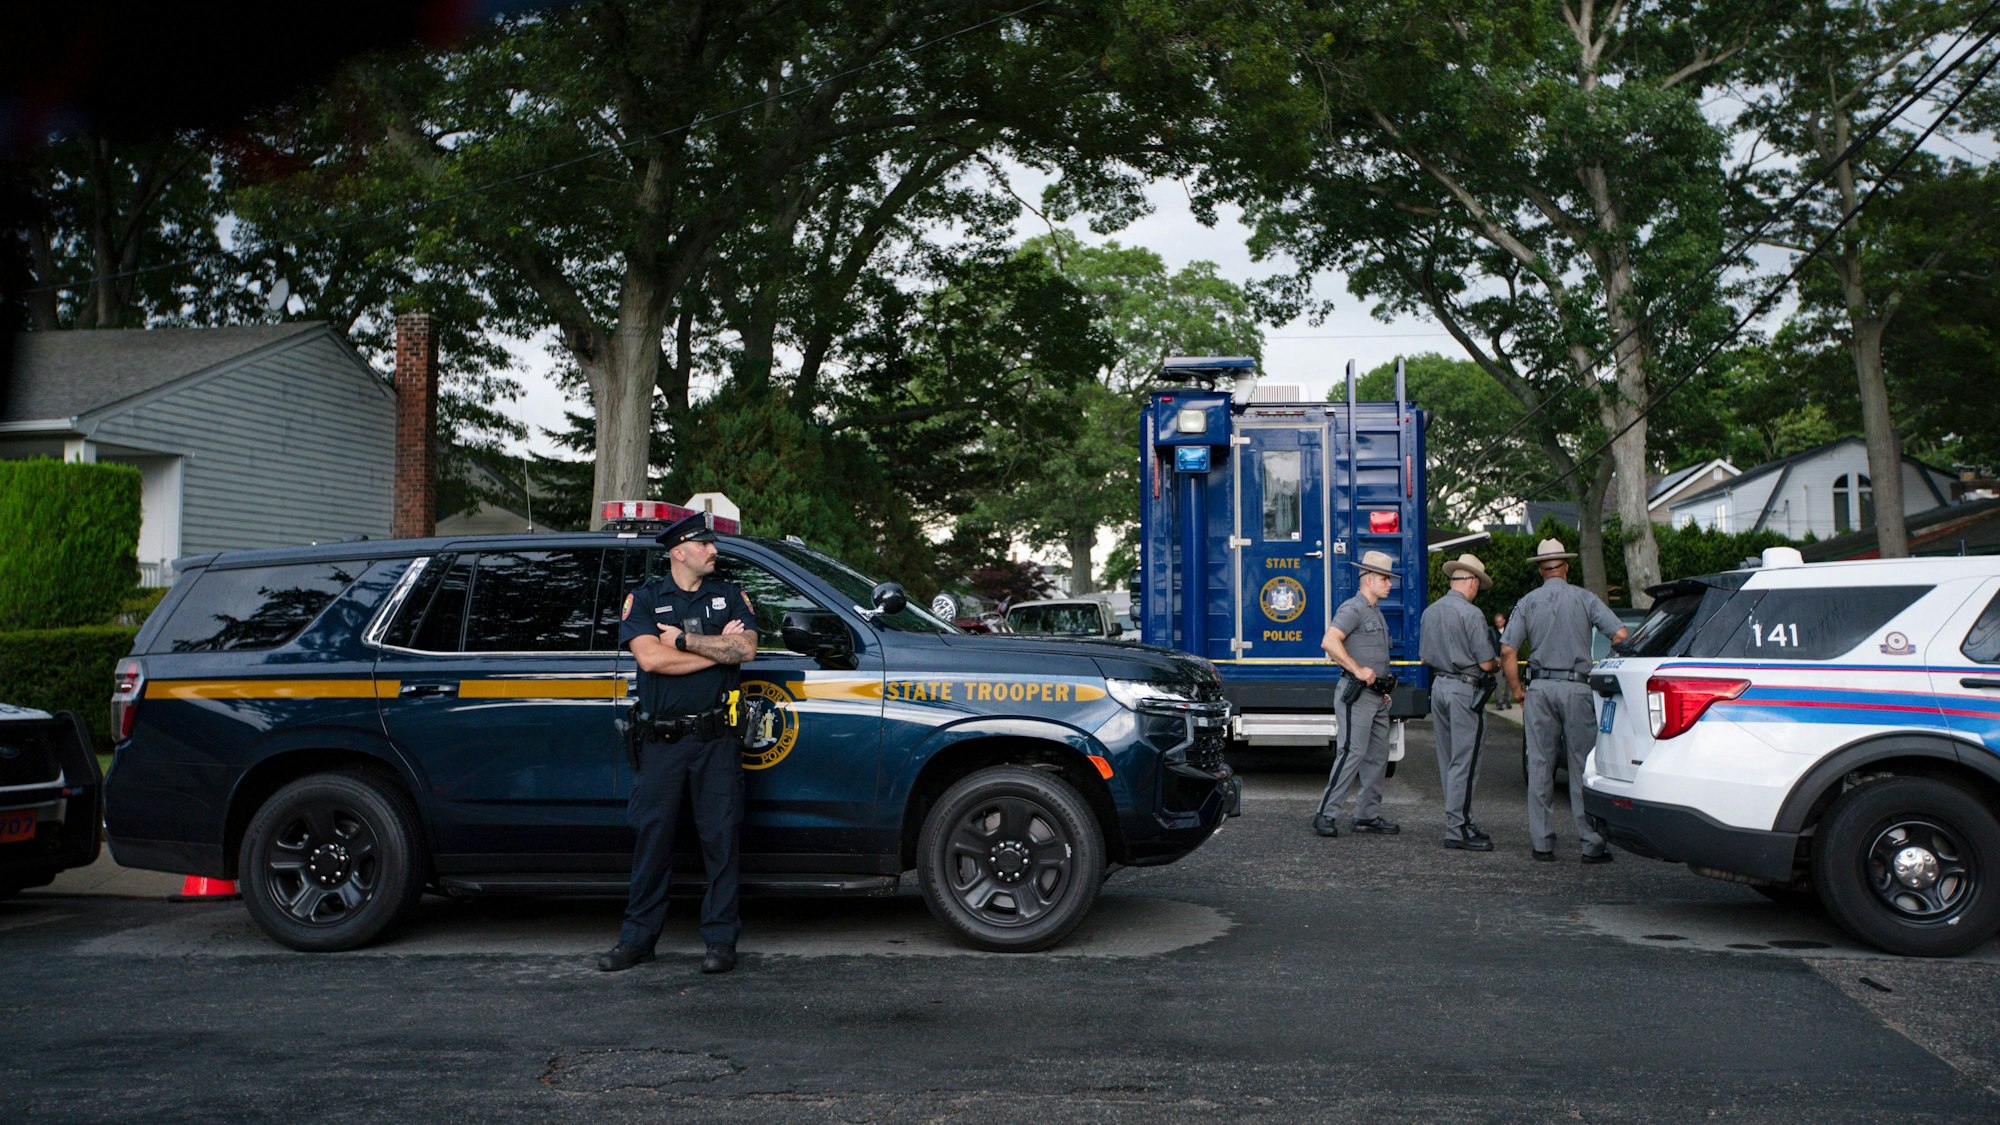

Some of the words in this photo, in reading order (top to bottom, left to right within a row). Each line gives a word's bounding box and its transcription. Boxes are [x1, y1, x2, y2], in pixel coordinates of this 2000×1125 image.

[1265, 557, 1301, 569] STATE
[1263, 630, 1302, 641] POLICE
[1752, 623, 1798, 647] 141
[886, 681, 953, 701] STATE
[964, 682, 1070, 702] TROOPER
[761, 727, 794, 764] POLICE
